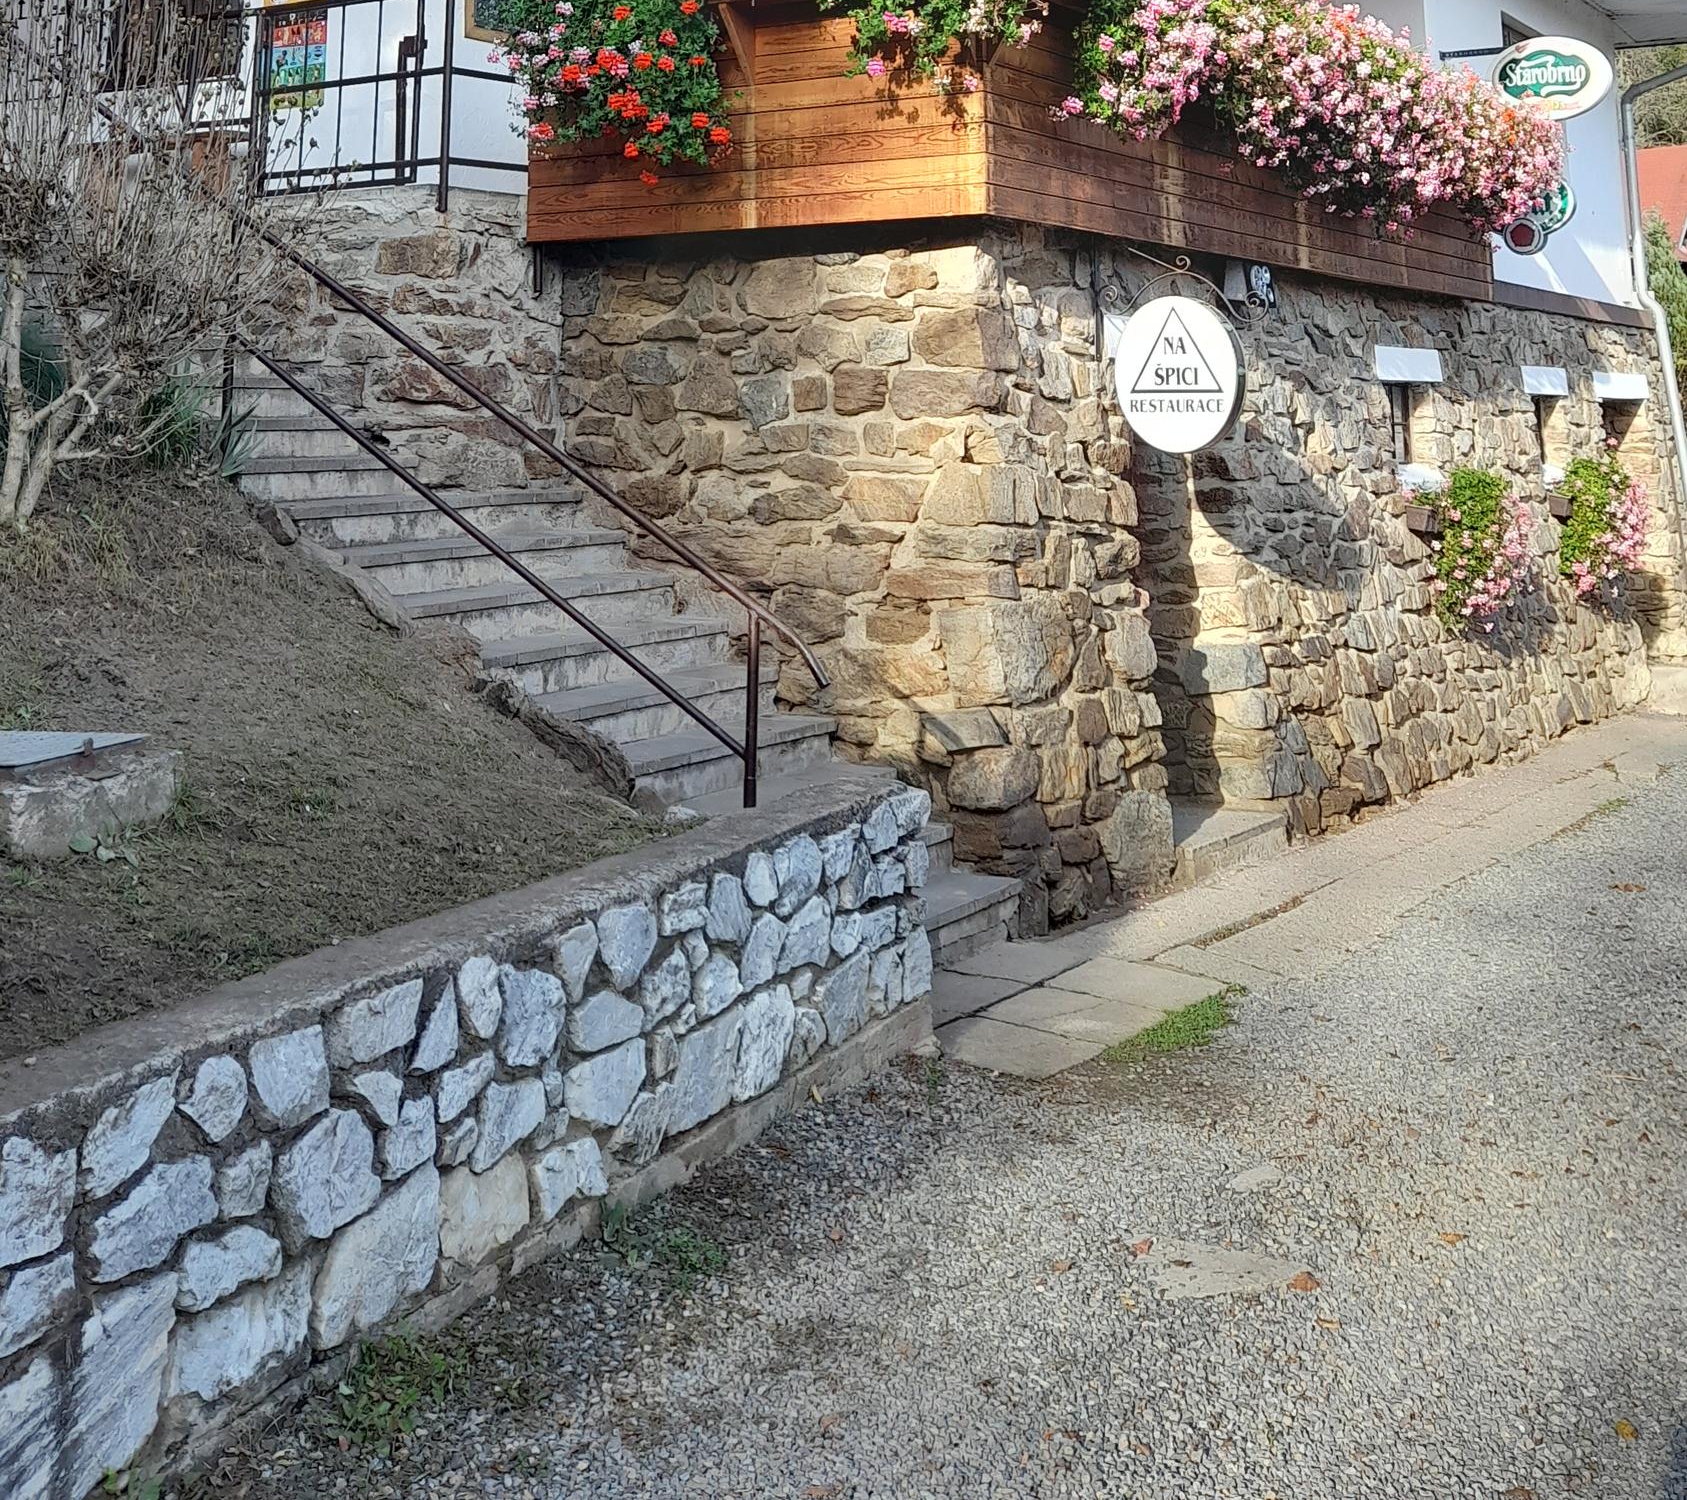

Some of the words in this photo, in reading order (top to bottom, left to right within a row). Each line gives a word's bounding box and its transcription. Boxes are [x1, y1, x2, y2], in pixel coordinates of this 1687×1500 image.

[1505, 56, 1587, 96] Starobrno
[1163, 336, 1187, 355] NA
[1154, 363, 1199, 386] ŠPICI
[1130, 398, 1225, 413] RESTAURACE
